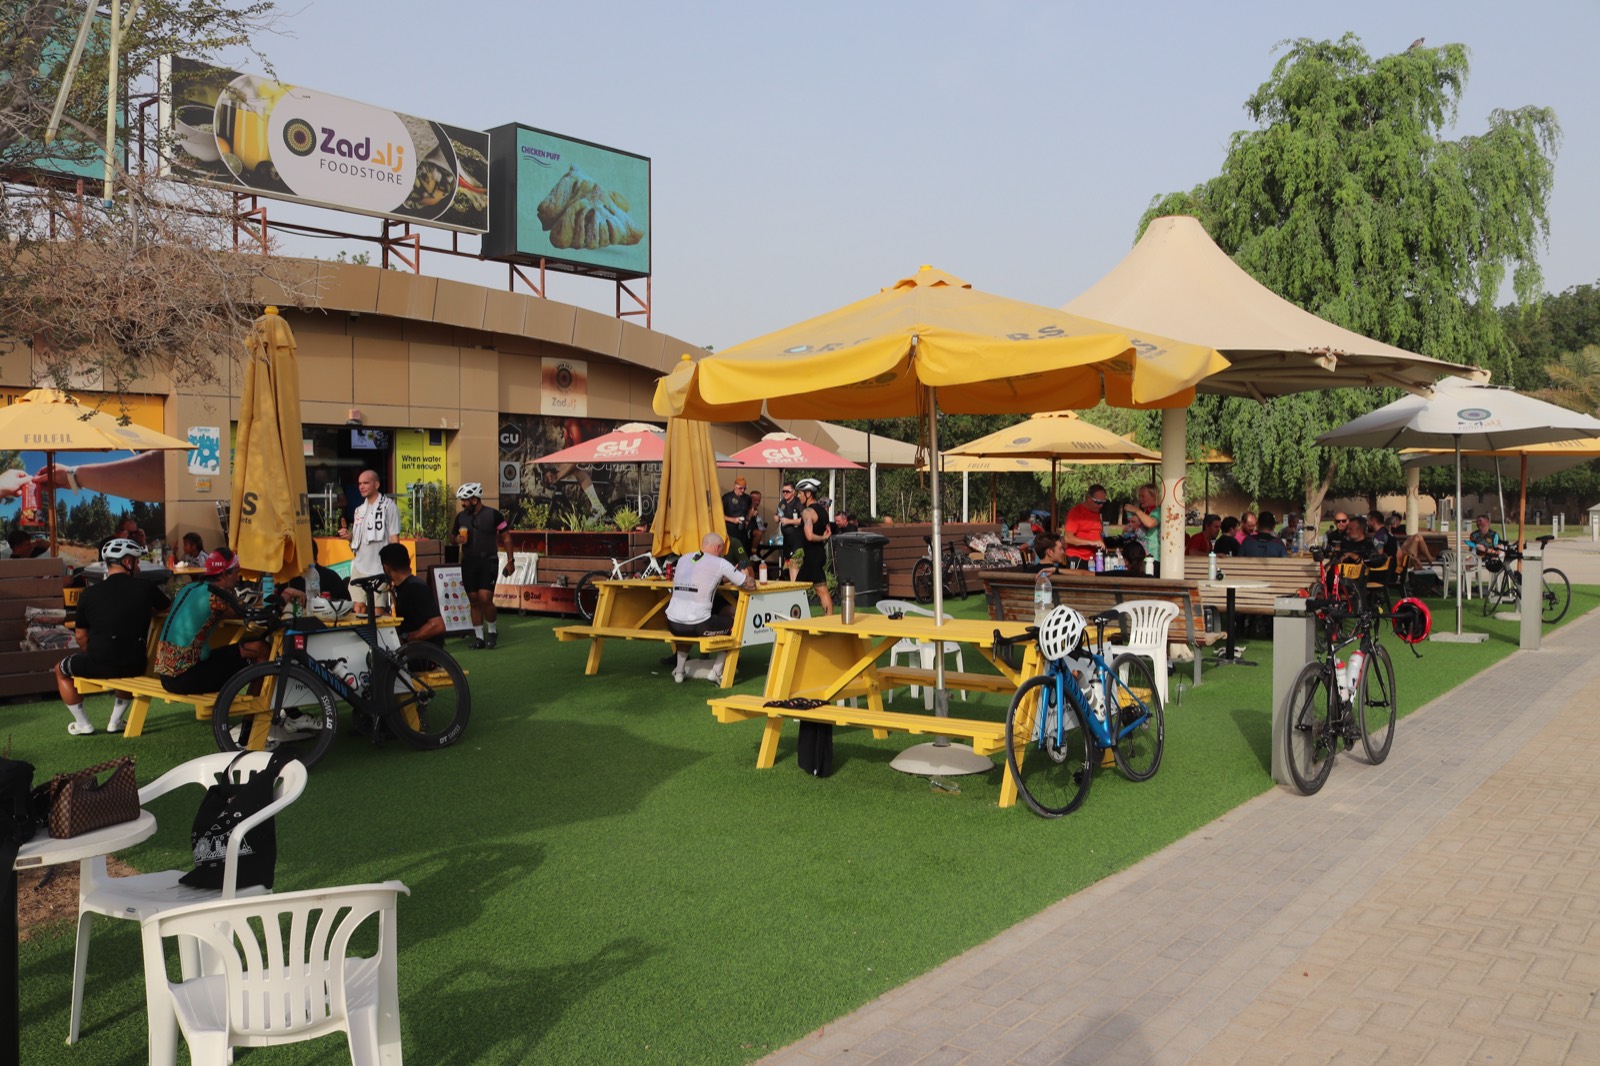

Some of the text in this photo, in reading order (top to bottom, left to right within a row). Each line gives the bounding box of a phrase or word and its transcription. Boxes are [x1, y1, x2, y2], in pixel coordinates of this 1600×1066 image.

[320, 127, 370, 161] Zad
[370, 143, 404, 173] زاد
[521, 146, 561, 161] CHICKEN PUFF
[320, 158, 403, 185] FOODSTORE
[551, 397, 567, 408] Zad
[24, 433, 73, 444] FULFIL
[500, 433, 519, 444] GU
[596, 438, 642, 453] GU
[402, 455, 442, 463] When water
[594, 451, 622, 459] FOR
[762, 446, 803, 459] GU
[401, 462, 442, 472] isn't enough
[502, 481, 513, 489] Zad
[308, 657, 348, 698] CANYON
[321, 695, 333, 730] DT SWISS
[439, 724, 462, 746] DT SWISS
